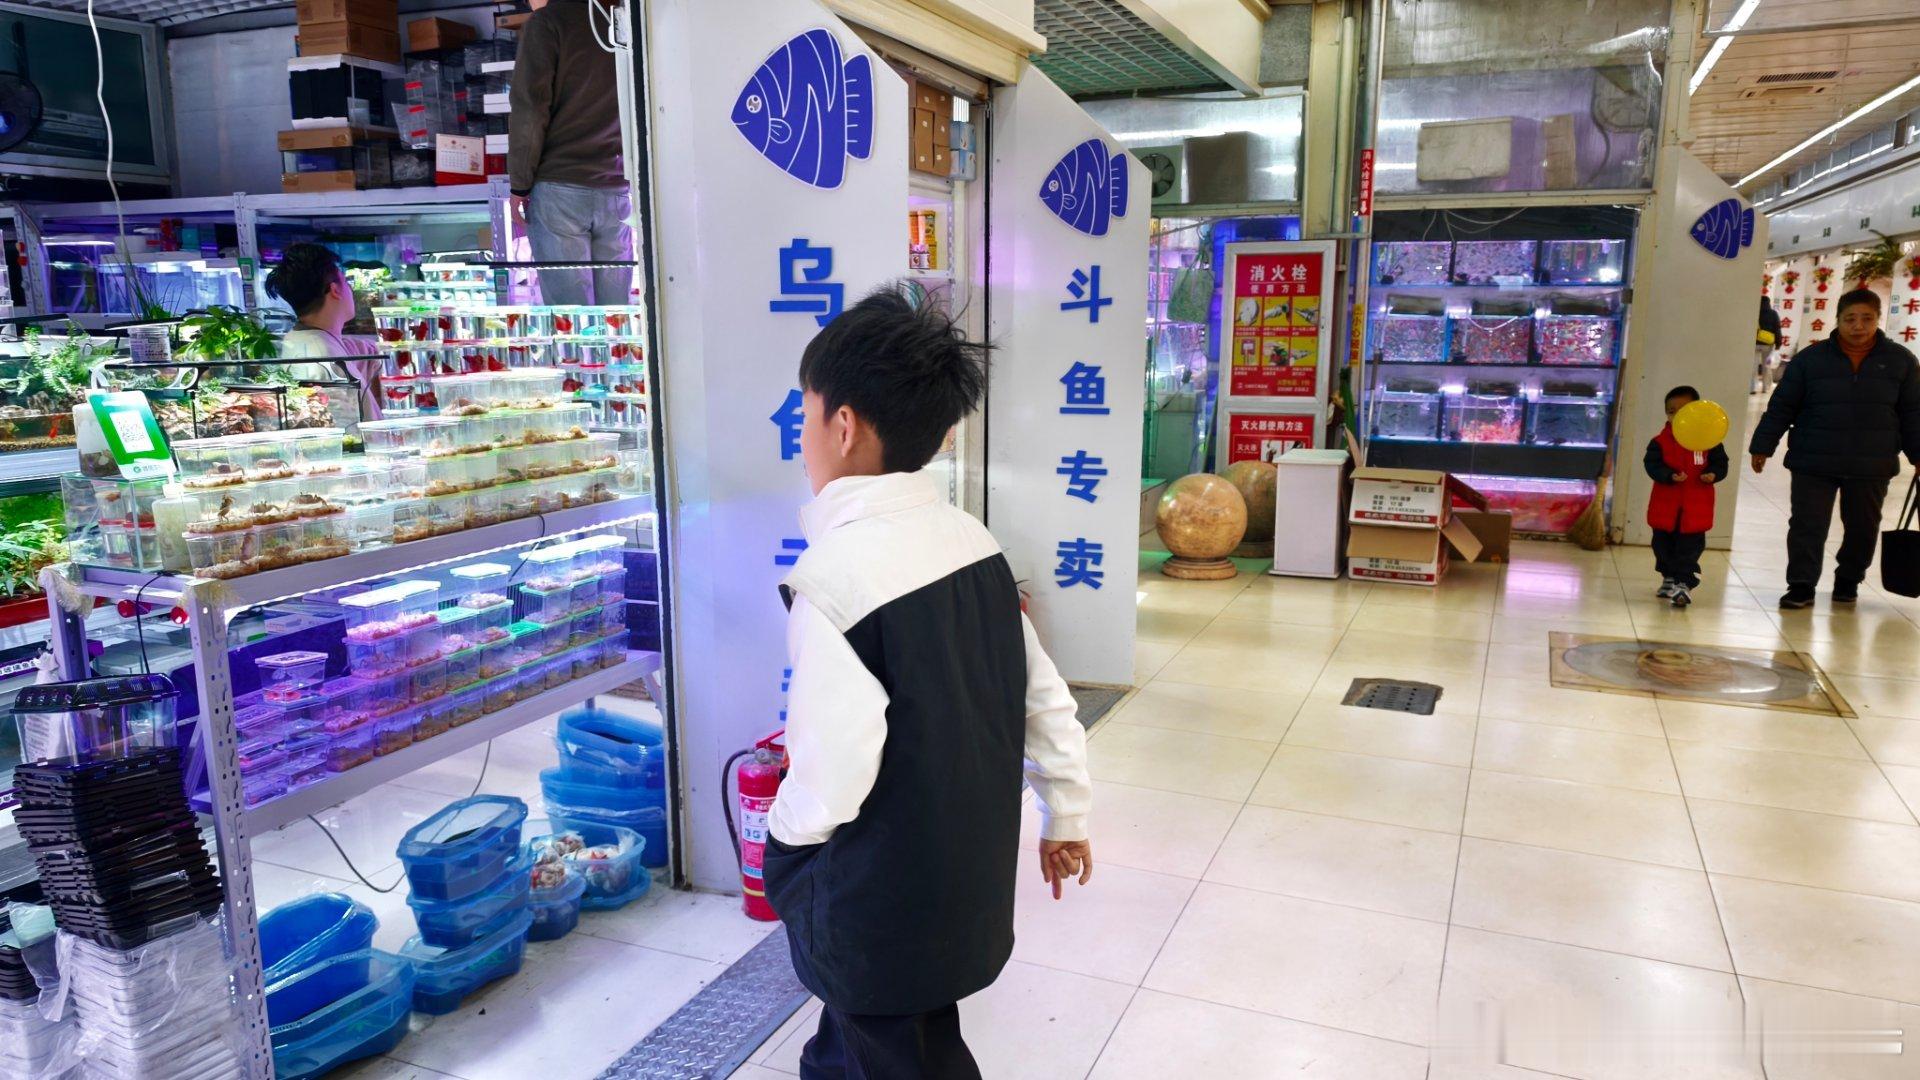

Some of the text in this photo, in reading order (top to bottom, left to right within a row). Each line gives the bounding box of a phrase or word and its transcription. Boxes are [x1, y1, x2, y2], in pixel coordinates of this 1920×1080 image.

[1250, 264, 1307, 281] 消火栓
[1250, 284, 1306, 294] 使用方法
[1779, 298, 1796, 360] 百合花
[1809, 298, 1828, 345] 百合
[1055, 265, 1112, 590] 斗鱼专卖
[1241, 420, 1304, 431] 灭火器使用方法
